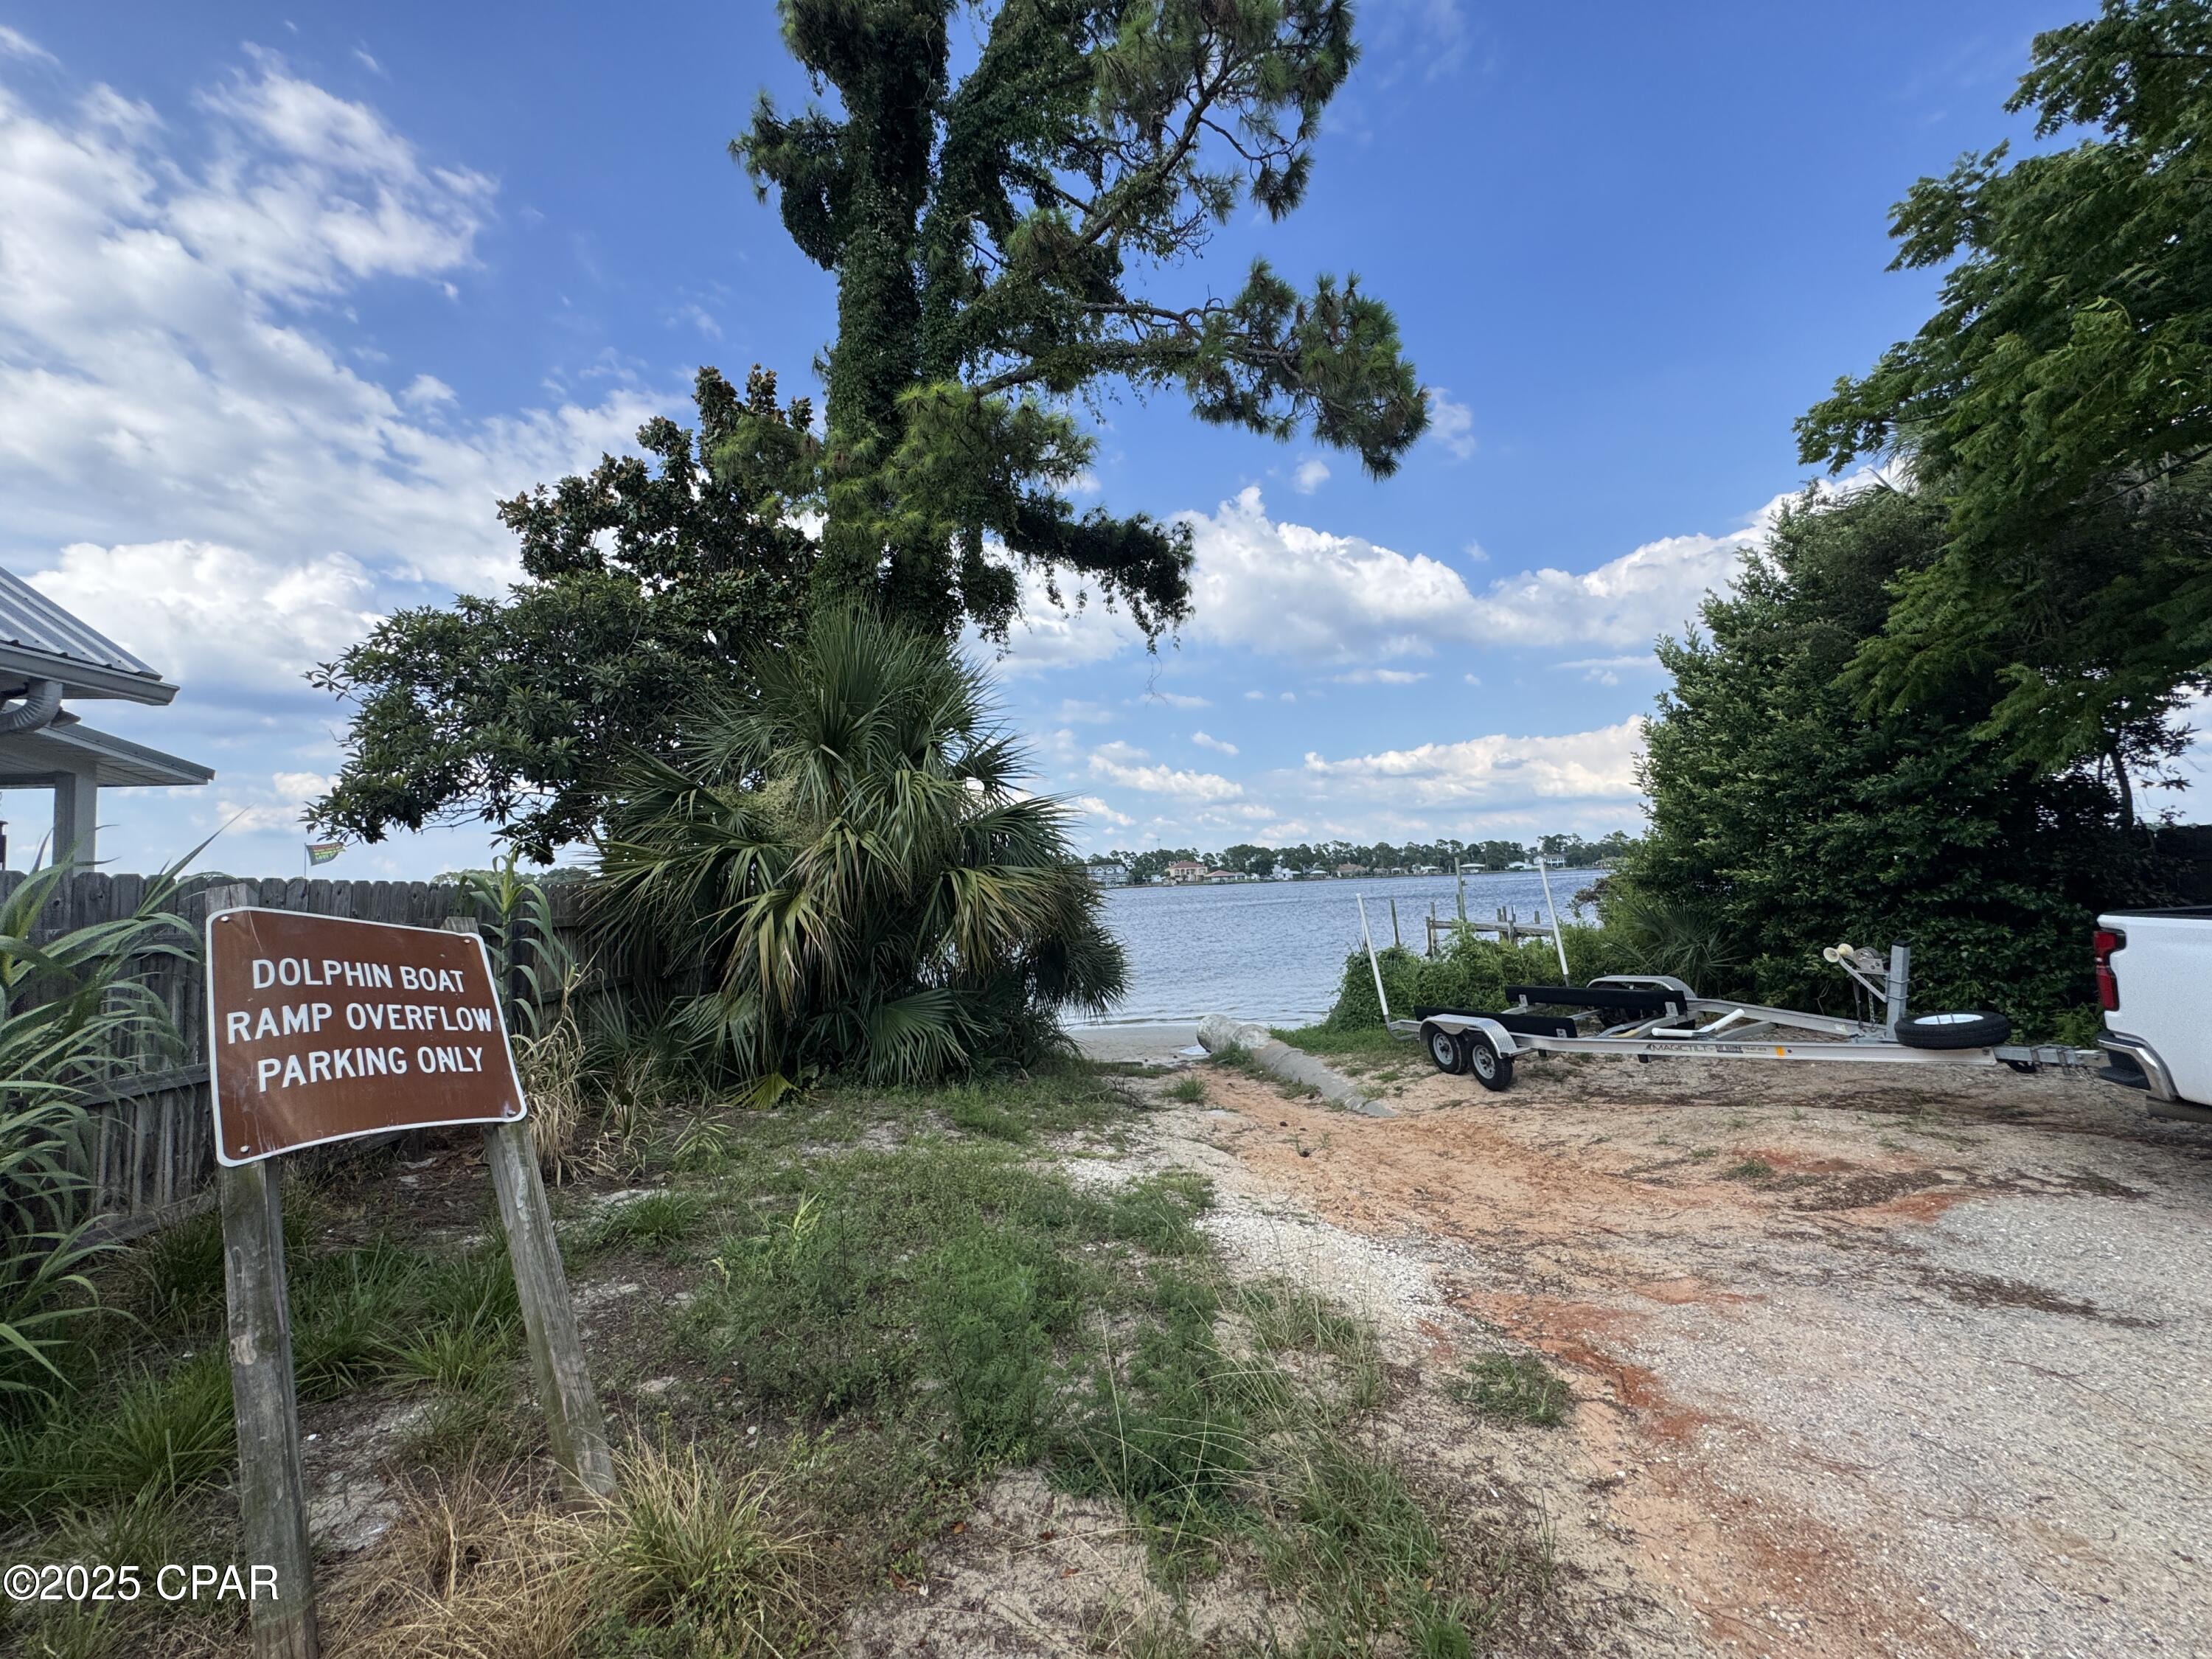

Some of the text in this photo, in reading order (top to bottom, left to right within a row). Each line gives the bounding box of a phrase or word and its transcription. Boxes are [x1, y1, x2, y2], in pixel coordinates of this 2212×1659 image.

[252, 959, 465, 993] DOLPHIN BOAT
[227, 1002, 493, 1045] RAMP OVERFLOW
[257, 1046, 483, 1093] PARKING ONLY
